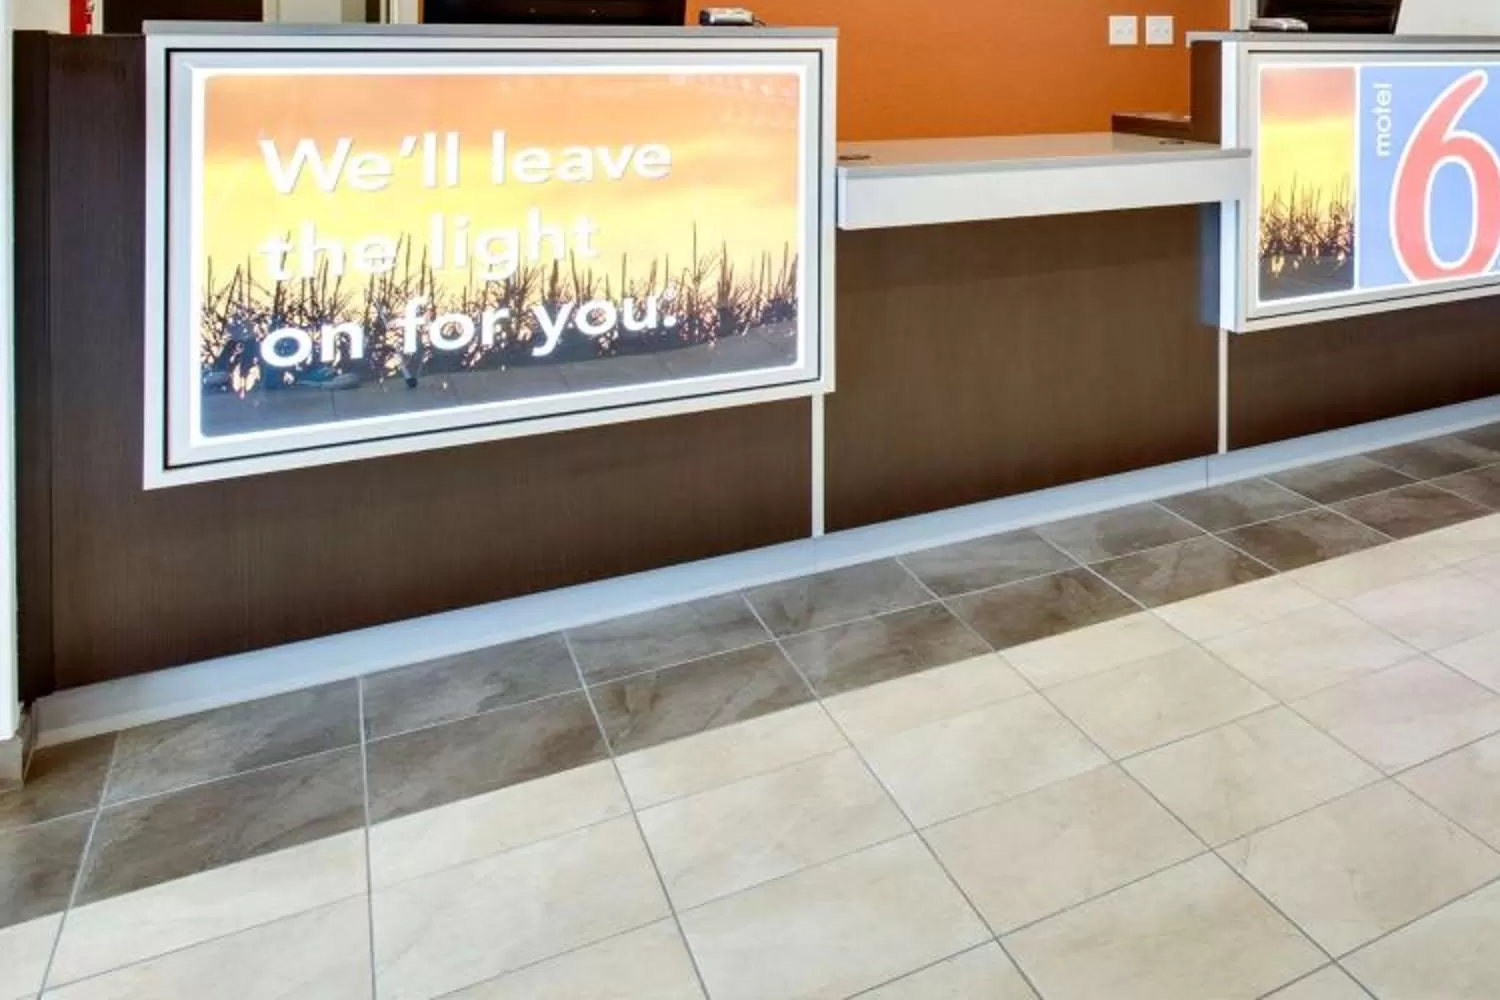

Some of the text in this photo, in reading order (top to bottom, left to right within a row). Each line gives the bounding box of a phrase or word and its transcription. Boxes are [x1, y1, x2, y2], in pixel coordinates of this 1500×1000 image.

[1371, 83, 1392, 158] motel
[259, 130, 672, 195] We'll leave
[260, 207, 600, 281] the light
[260, 320, 364, 368] on
[400, 297, 510, 355] for
